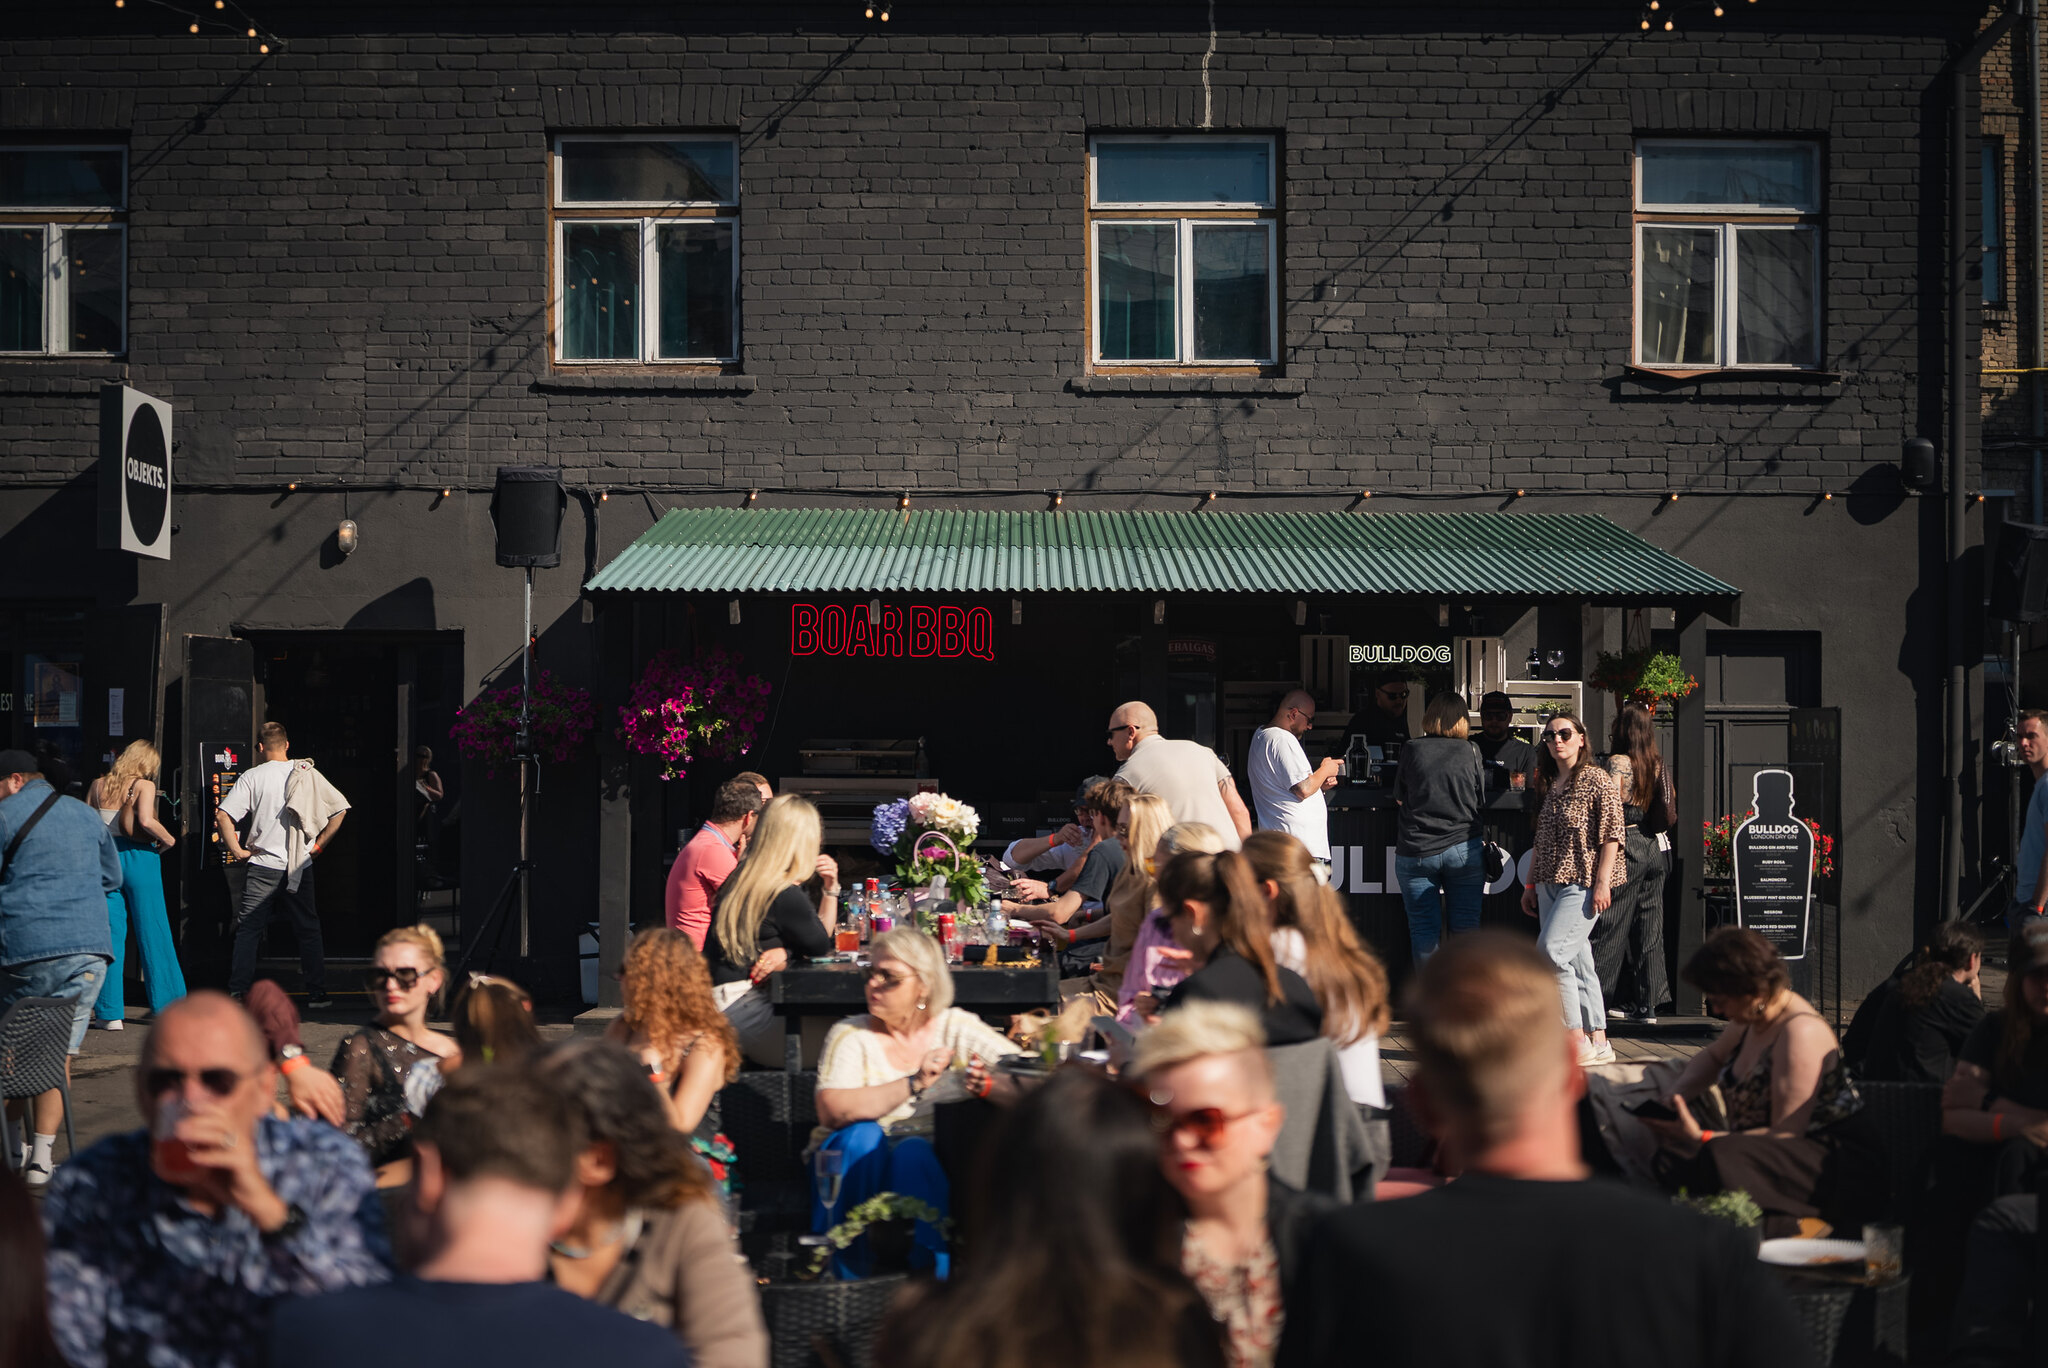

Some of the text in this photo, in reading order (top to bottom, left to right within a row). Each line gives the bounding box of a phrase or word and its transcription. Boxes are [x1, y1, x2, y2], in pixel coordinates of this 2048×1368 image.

[127, 456, 166, 490] OBJEKTS.
[791, 603, 995, 661] BOAR BBQ
[1168, 642, 1215, 655] EBALGAS
[1349, 645, 1452, 663] BULLDOG
[1748, 824, 1799, 834] BULLDOG
